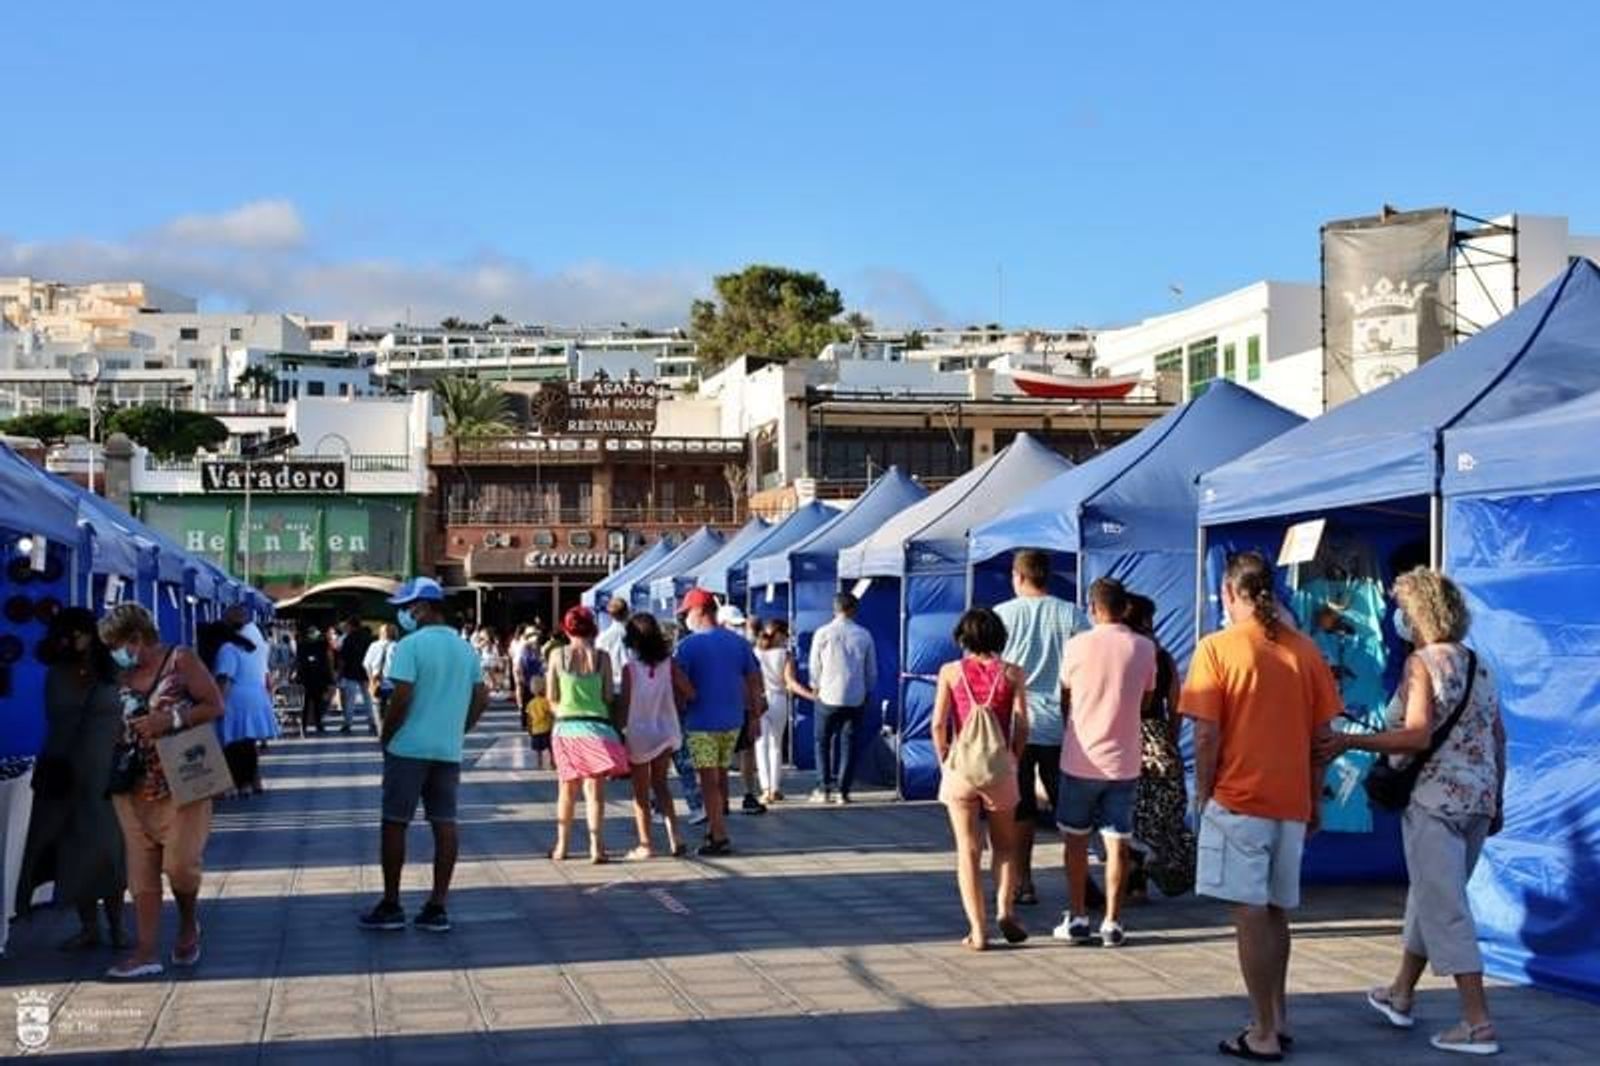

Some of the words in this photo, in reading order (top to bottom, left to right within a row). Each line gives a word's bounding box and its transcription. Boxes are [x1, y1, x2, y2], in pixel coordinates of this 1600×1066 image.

[567, 382, 586, 395] EL
[570, 399, 610, 410] STEAK
[614, 399, 655, 410] HOUSE
[567, 420, 655, 432] RESTAURANT
[207, 464, 339, 488] Varadero
